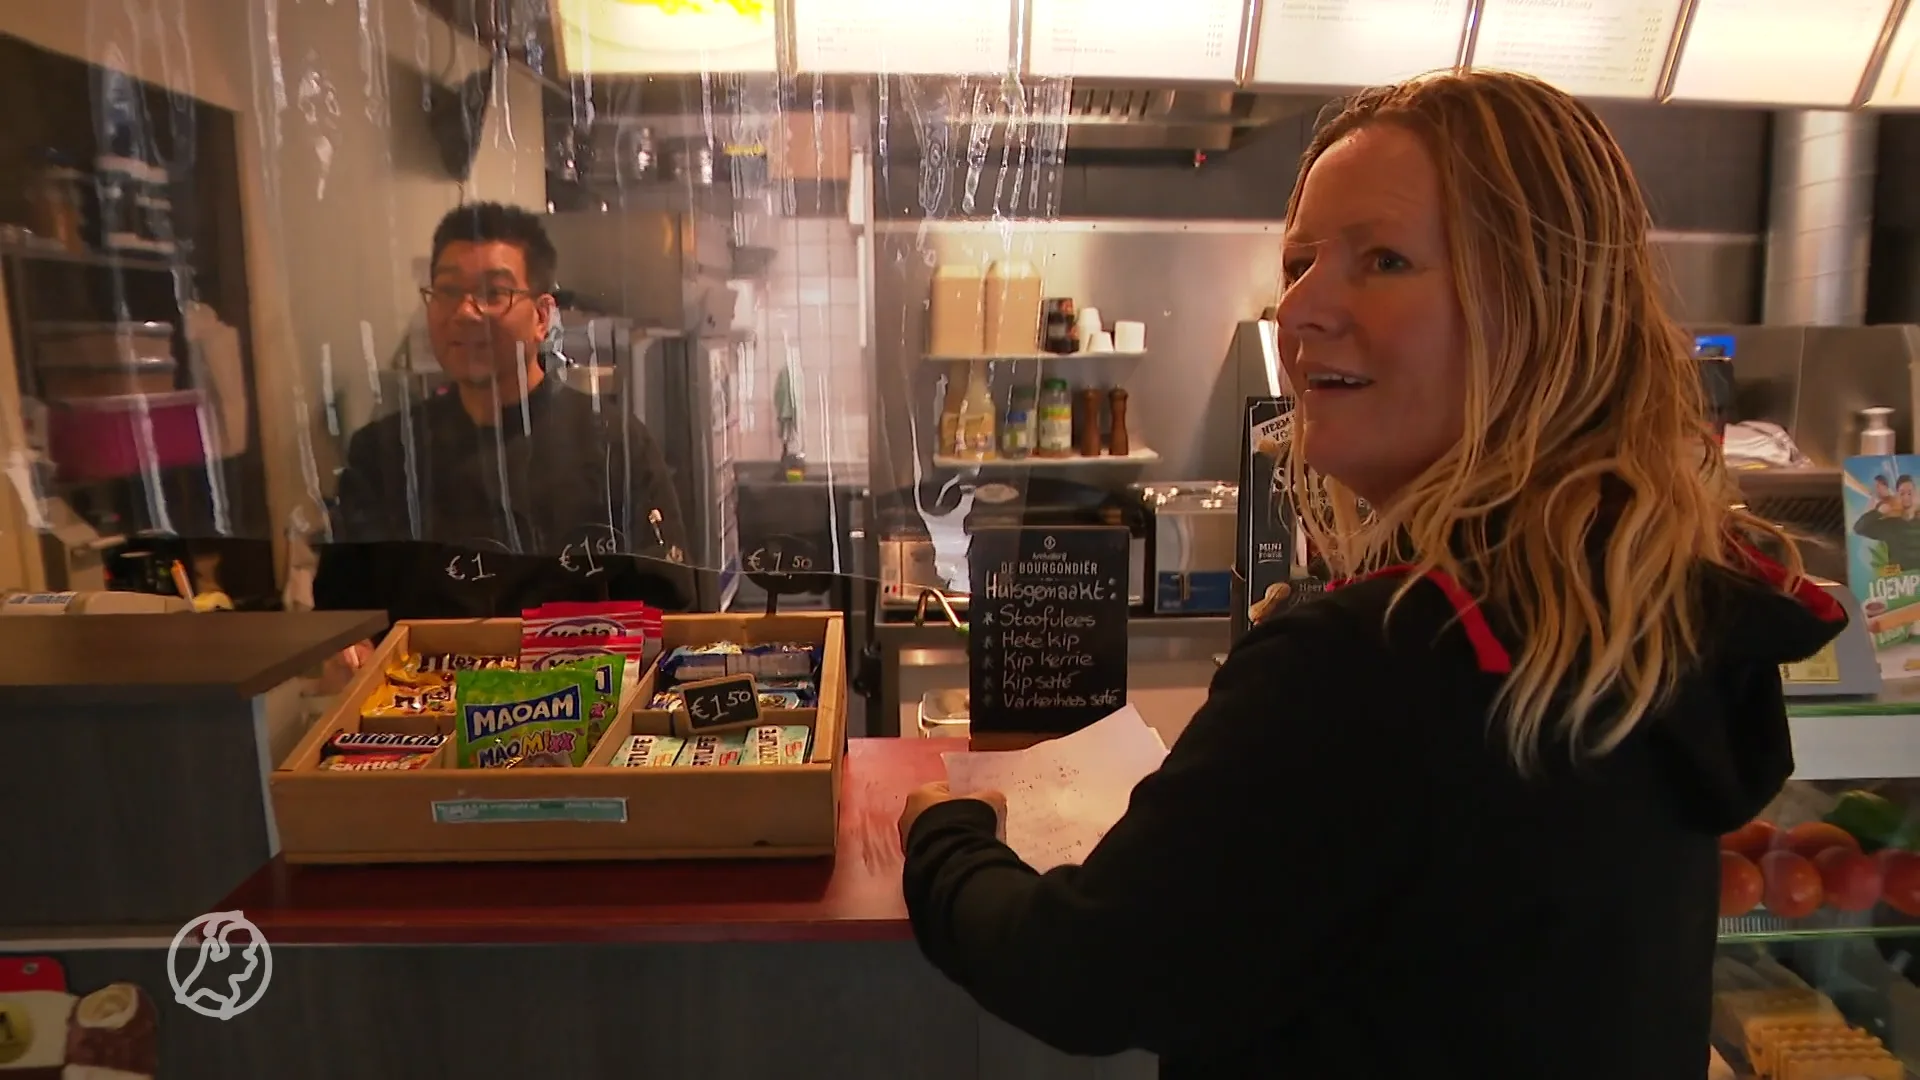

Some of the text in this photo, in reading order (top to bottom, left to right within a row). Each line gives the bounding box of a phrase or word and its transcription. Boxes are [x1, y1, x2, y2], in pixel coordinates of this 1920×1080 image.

[445, 552, 496, 582] €1
[1019, 560, 1098, 575] BOURGONDIËR
[472, 693, 574, 736] MAOAM
